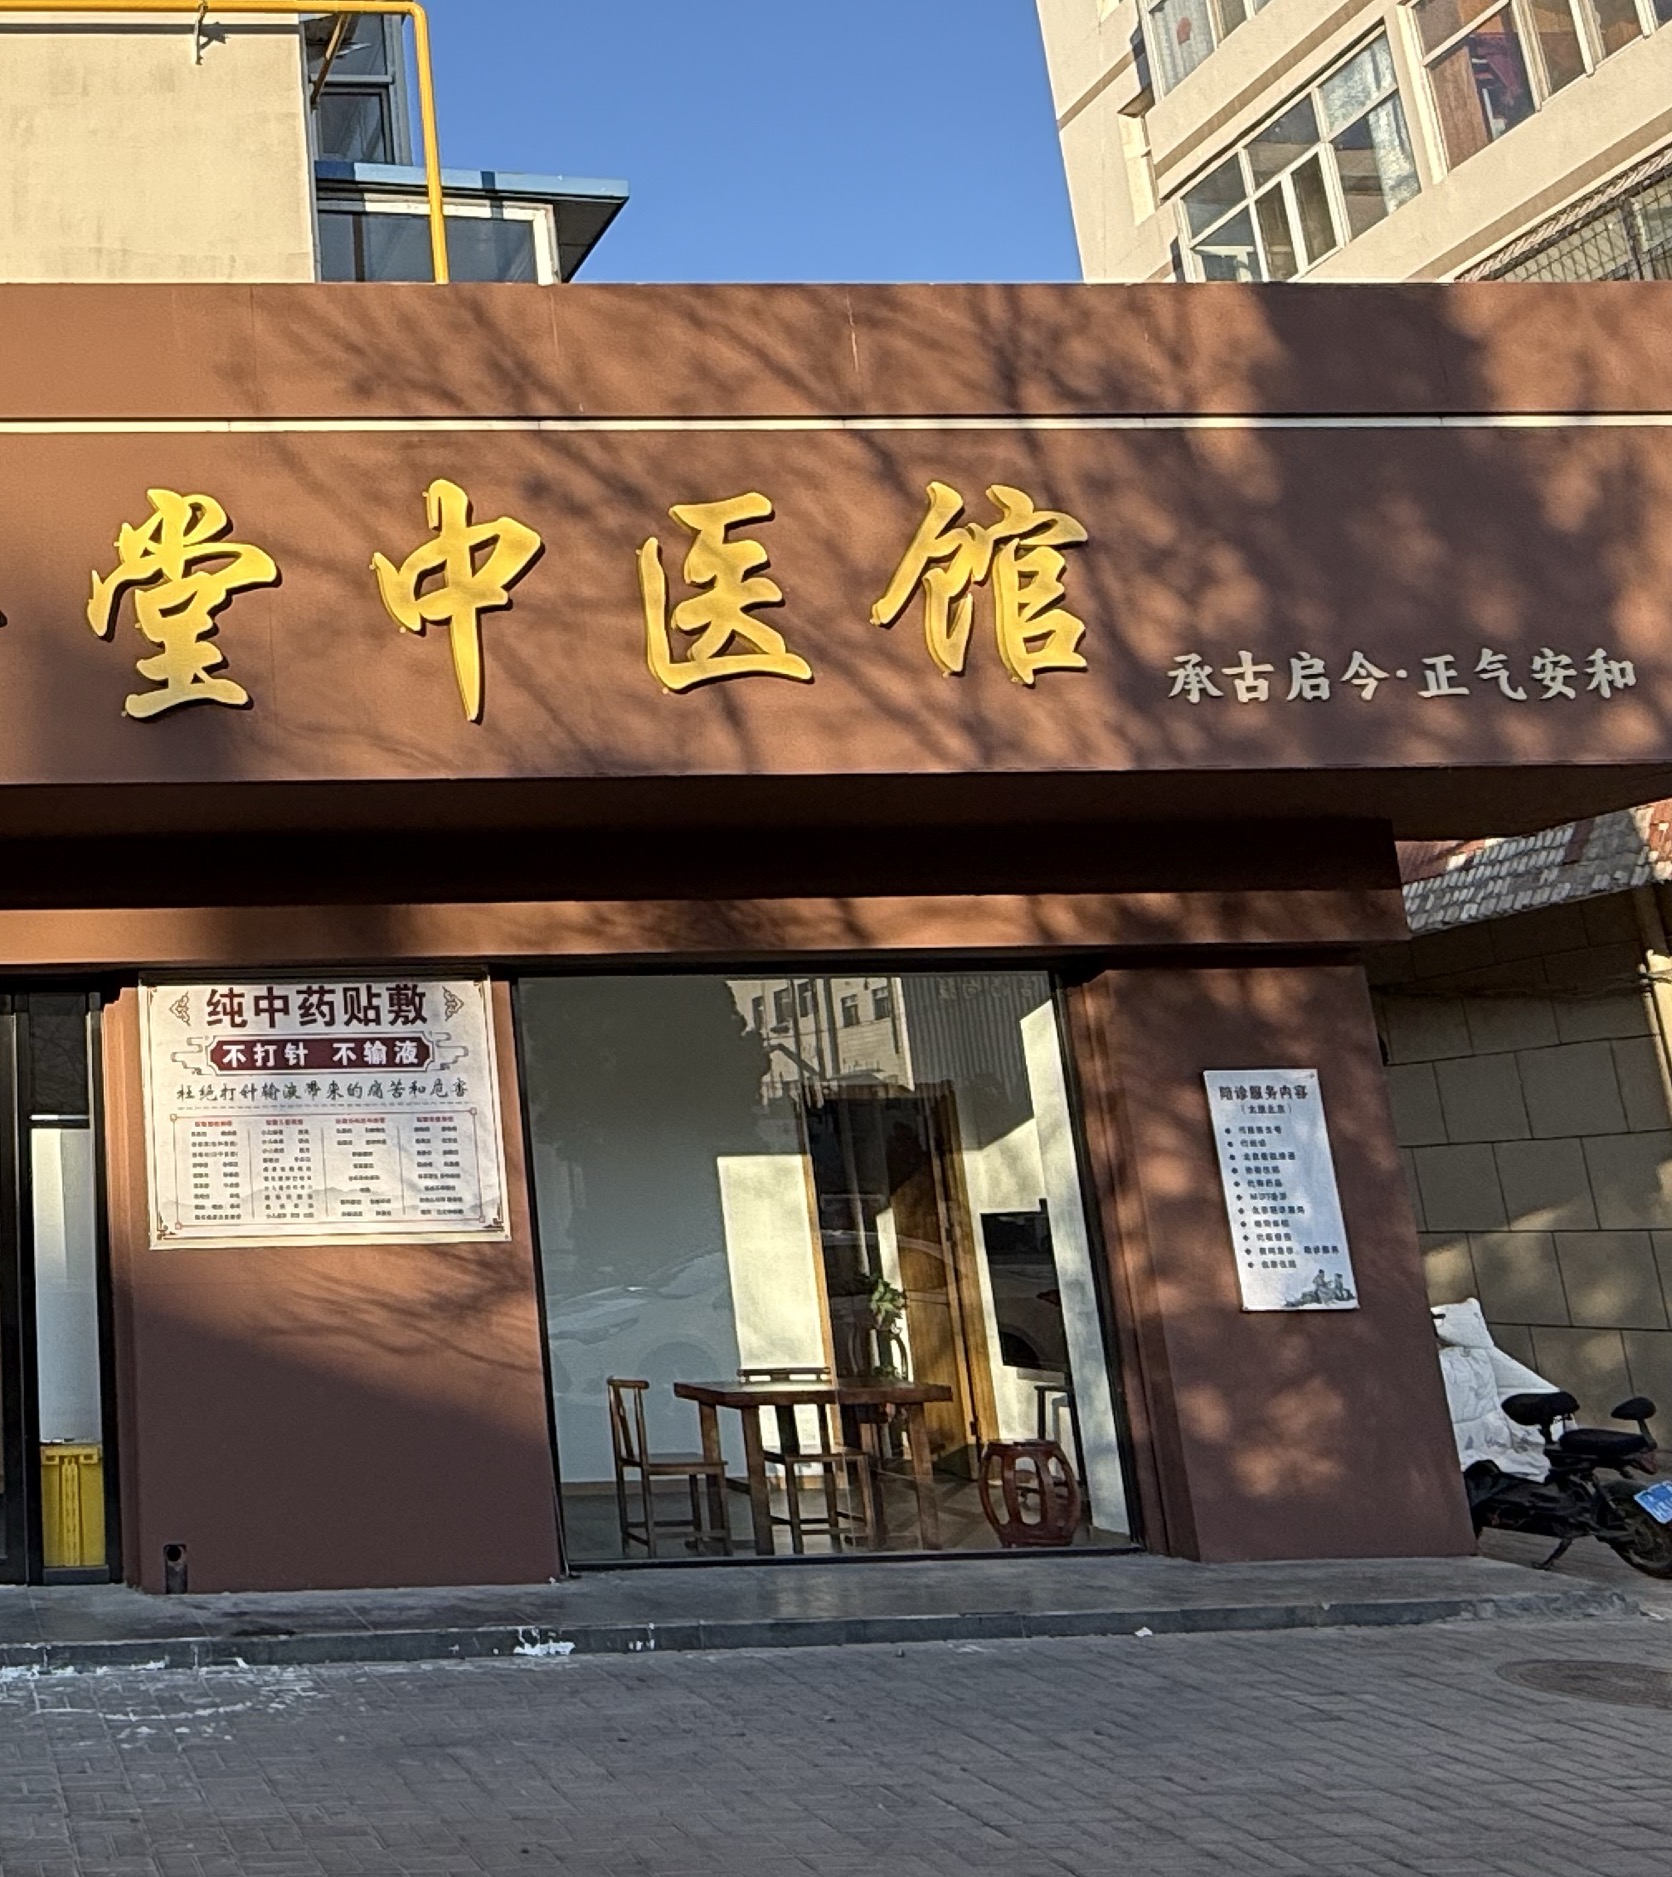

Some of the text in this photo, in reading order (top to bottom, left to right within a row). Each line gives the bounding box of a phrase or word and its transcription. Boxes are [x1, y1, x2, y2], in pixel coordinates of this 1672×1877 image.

[1167, 647, 1637, 703] 承古启今·正气安和
[206, 984, 427, 1028] 纯中药贴敷
[222, 1040, 419, 1067] 不打针 不输液
